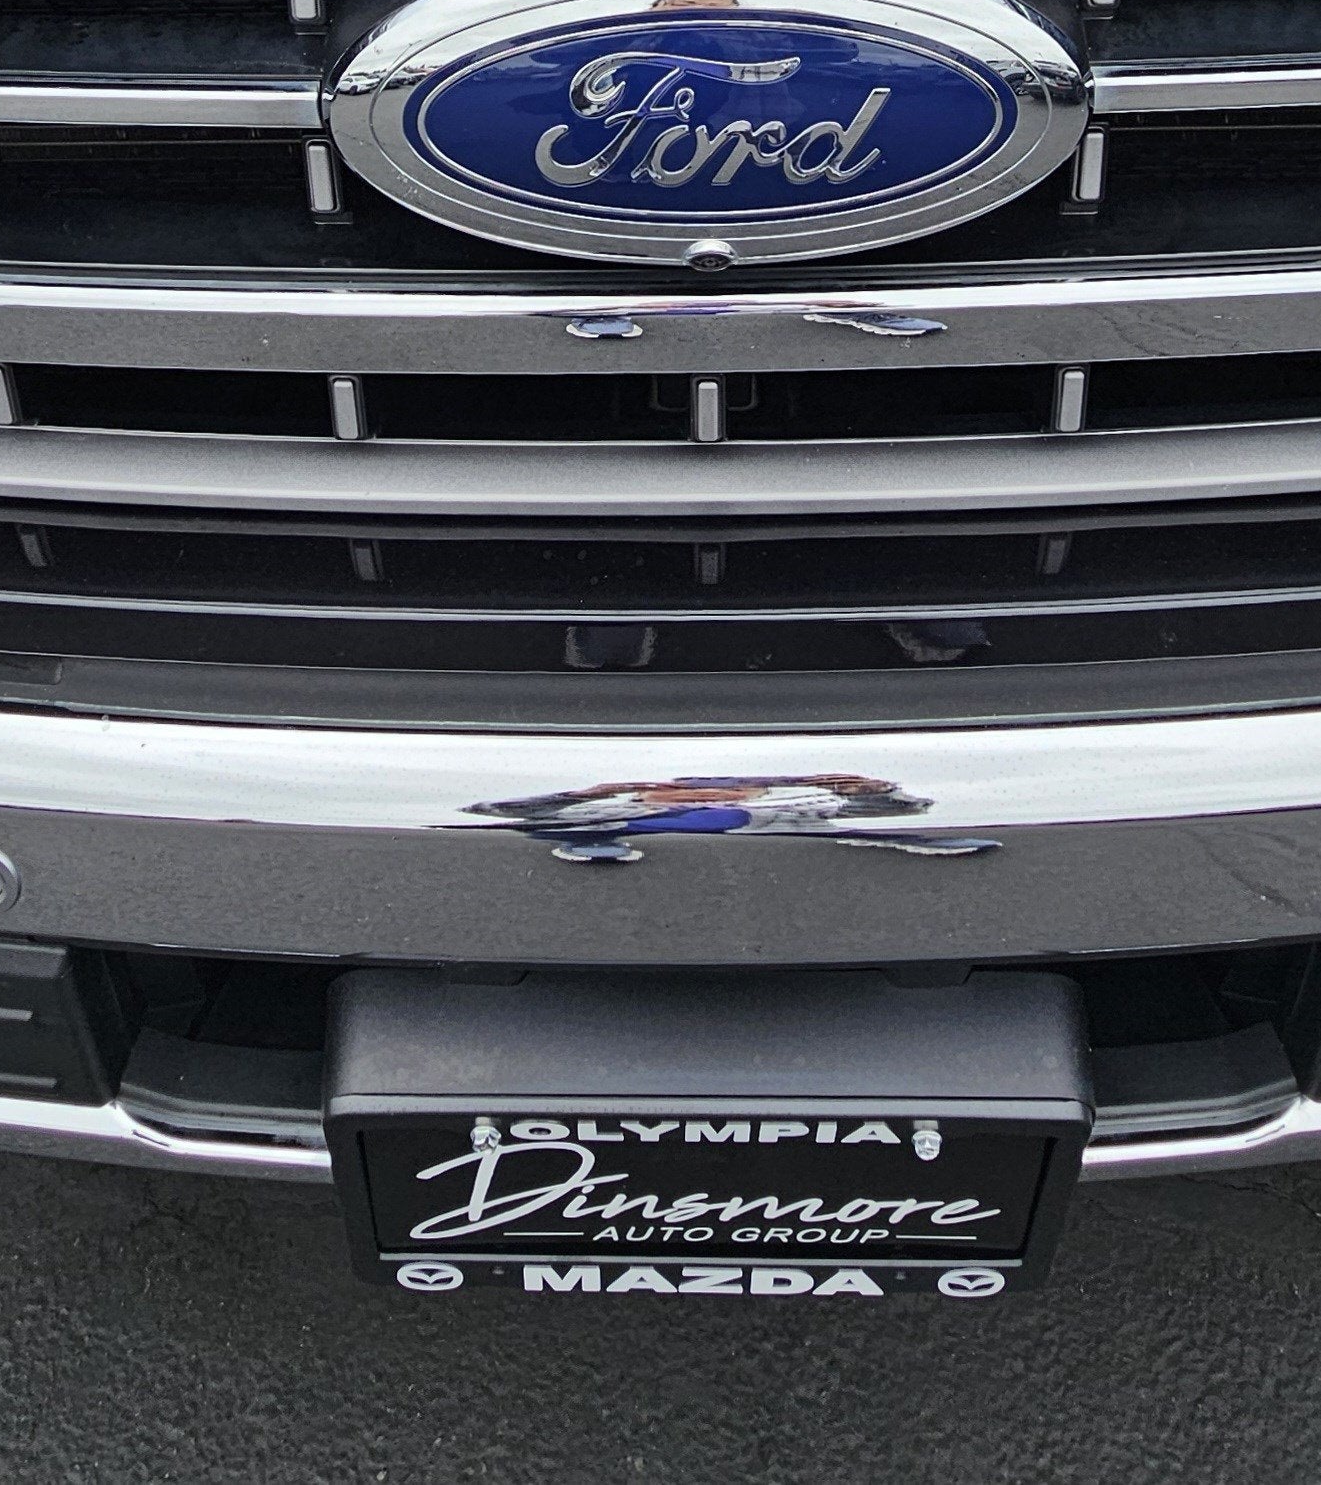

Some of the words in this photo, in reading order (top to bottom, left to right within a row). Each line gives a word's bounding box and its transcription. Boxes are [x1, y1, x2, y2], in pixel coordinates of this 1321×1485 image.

[535, 51, 891, 188] Ford
[509, 1119, 902, 1145] OLYMPIA
[409, 1140, 1002, 1240] Dinsmore
[592, 1225, 714, 1243] AUTO
[730, 1226, 890, 1245] GROUP
[522, 1264, 885, 1297] MAZDA
